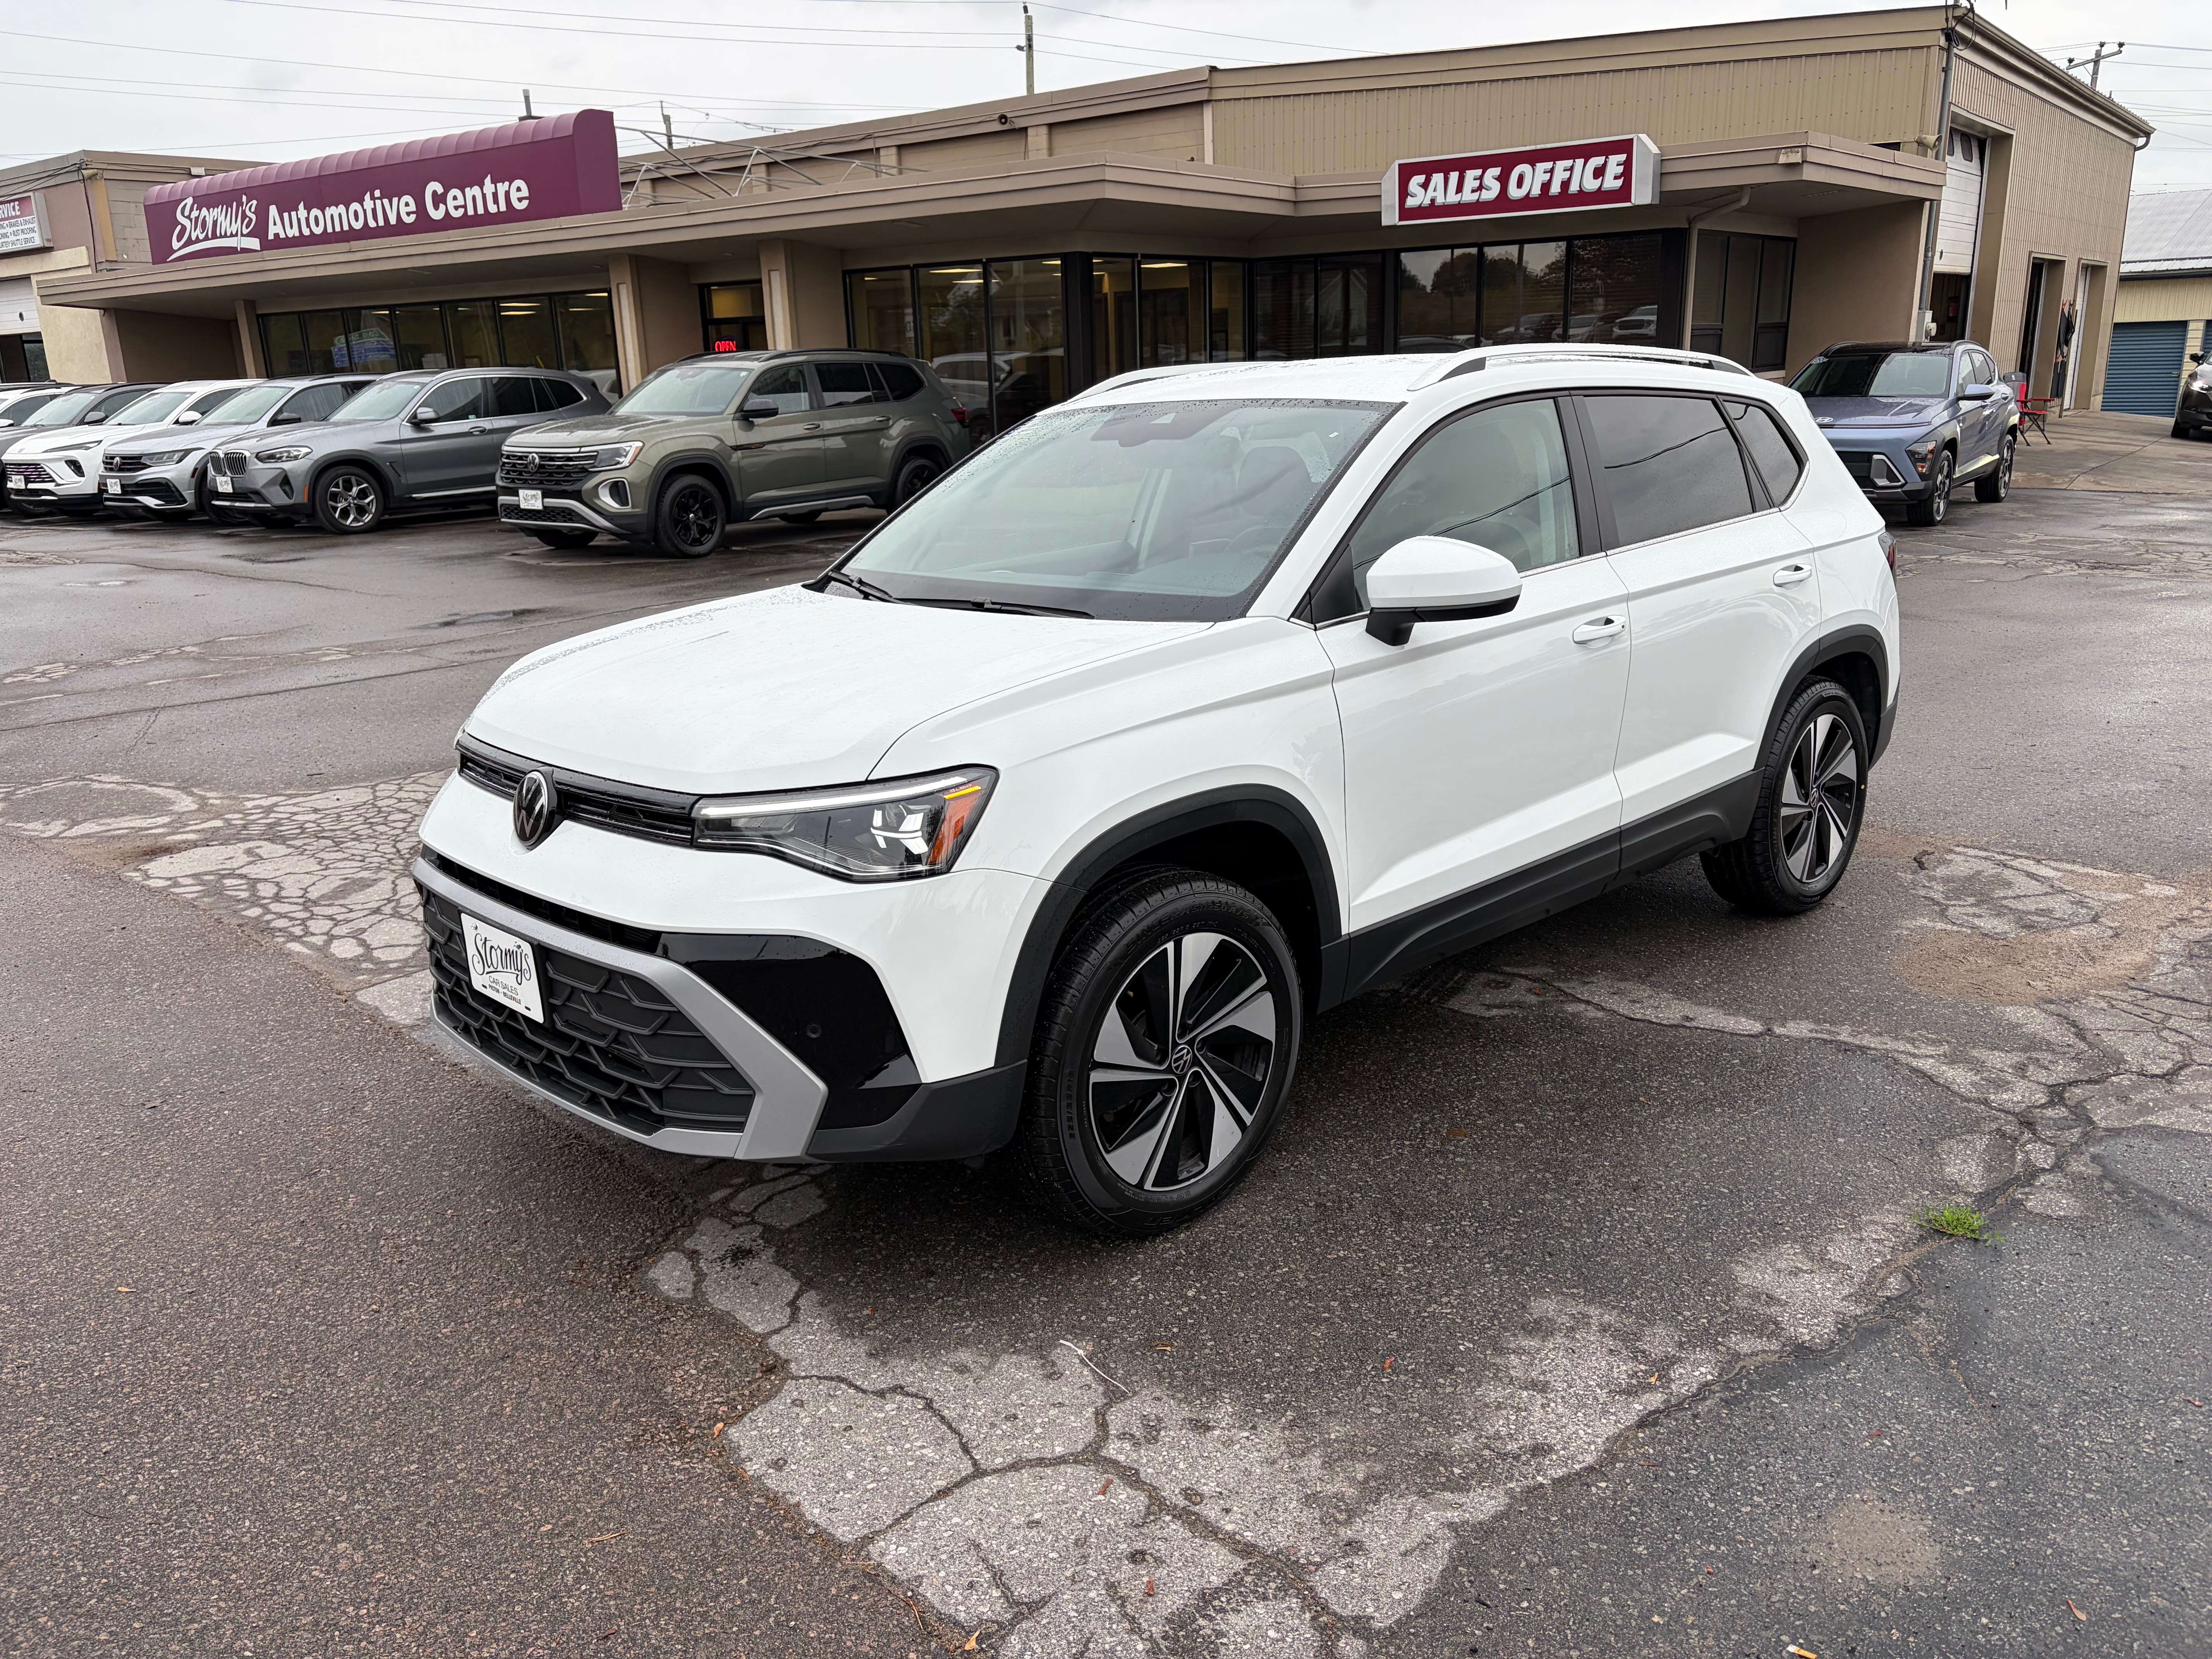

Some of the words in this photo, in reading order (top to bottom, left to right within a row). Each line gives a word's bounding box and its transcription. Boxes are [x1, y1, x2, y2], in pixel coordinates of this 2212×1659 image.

[1405, 167, 1501, 208] SALES
[1508, 154, 1627, 200] OFFICE
[172, 194, 257, 251] Stormy's
[268, 189, 417, 240] Automotive
[424, 174, 529, 220] Centre
[9, 220, 20, 228] BRAKES
[22, 217, 36, 225] EXHAUST
[21, 226, 36, 235] PROOFING
[10, 239, 23, 247] SHUTTLE
[23, 237, 35, 245] SERVICE
[715, 341, 736, 352] OPEN
[472, 933, 531, 985] Stormy's
[489, 975, 500, 988] CAR
[501, 981, 518, 996] SALES
[503, 991, 521, 1005] BELLEVILLE
